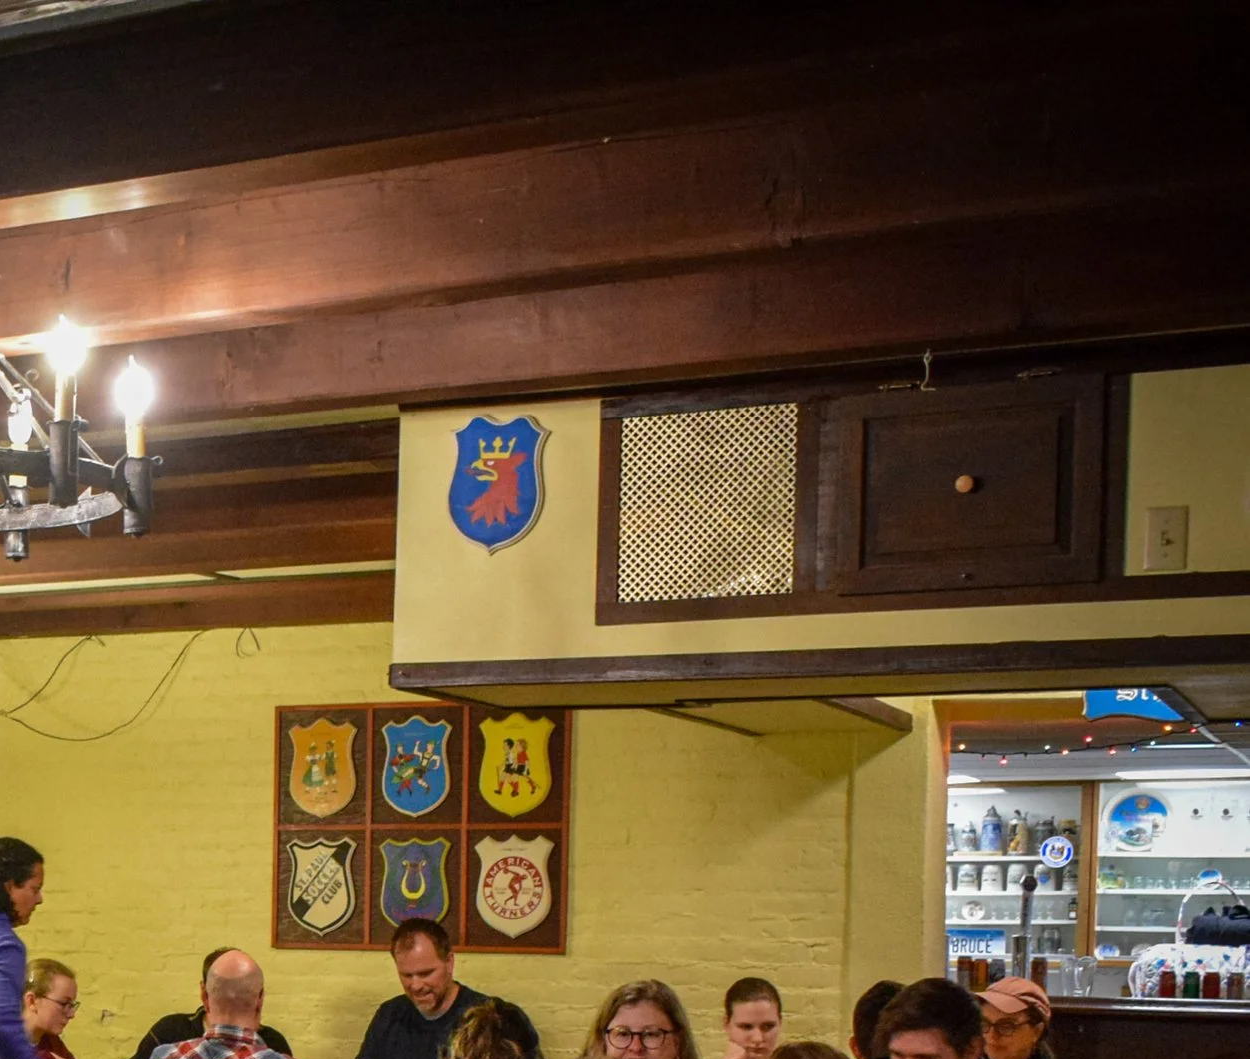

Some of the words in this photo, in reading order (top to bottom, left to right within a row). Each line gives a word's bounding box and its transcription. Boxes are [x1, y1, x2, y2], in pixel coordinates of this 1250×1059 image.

[485, 857, 543, 888] AMERICAN
[320, 879, 343, 905] CLUB
[483, 888, 542, 918] TURNERS
[951, 938, 993, 954] BRUCE
